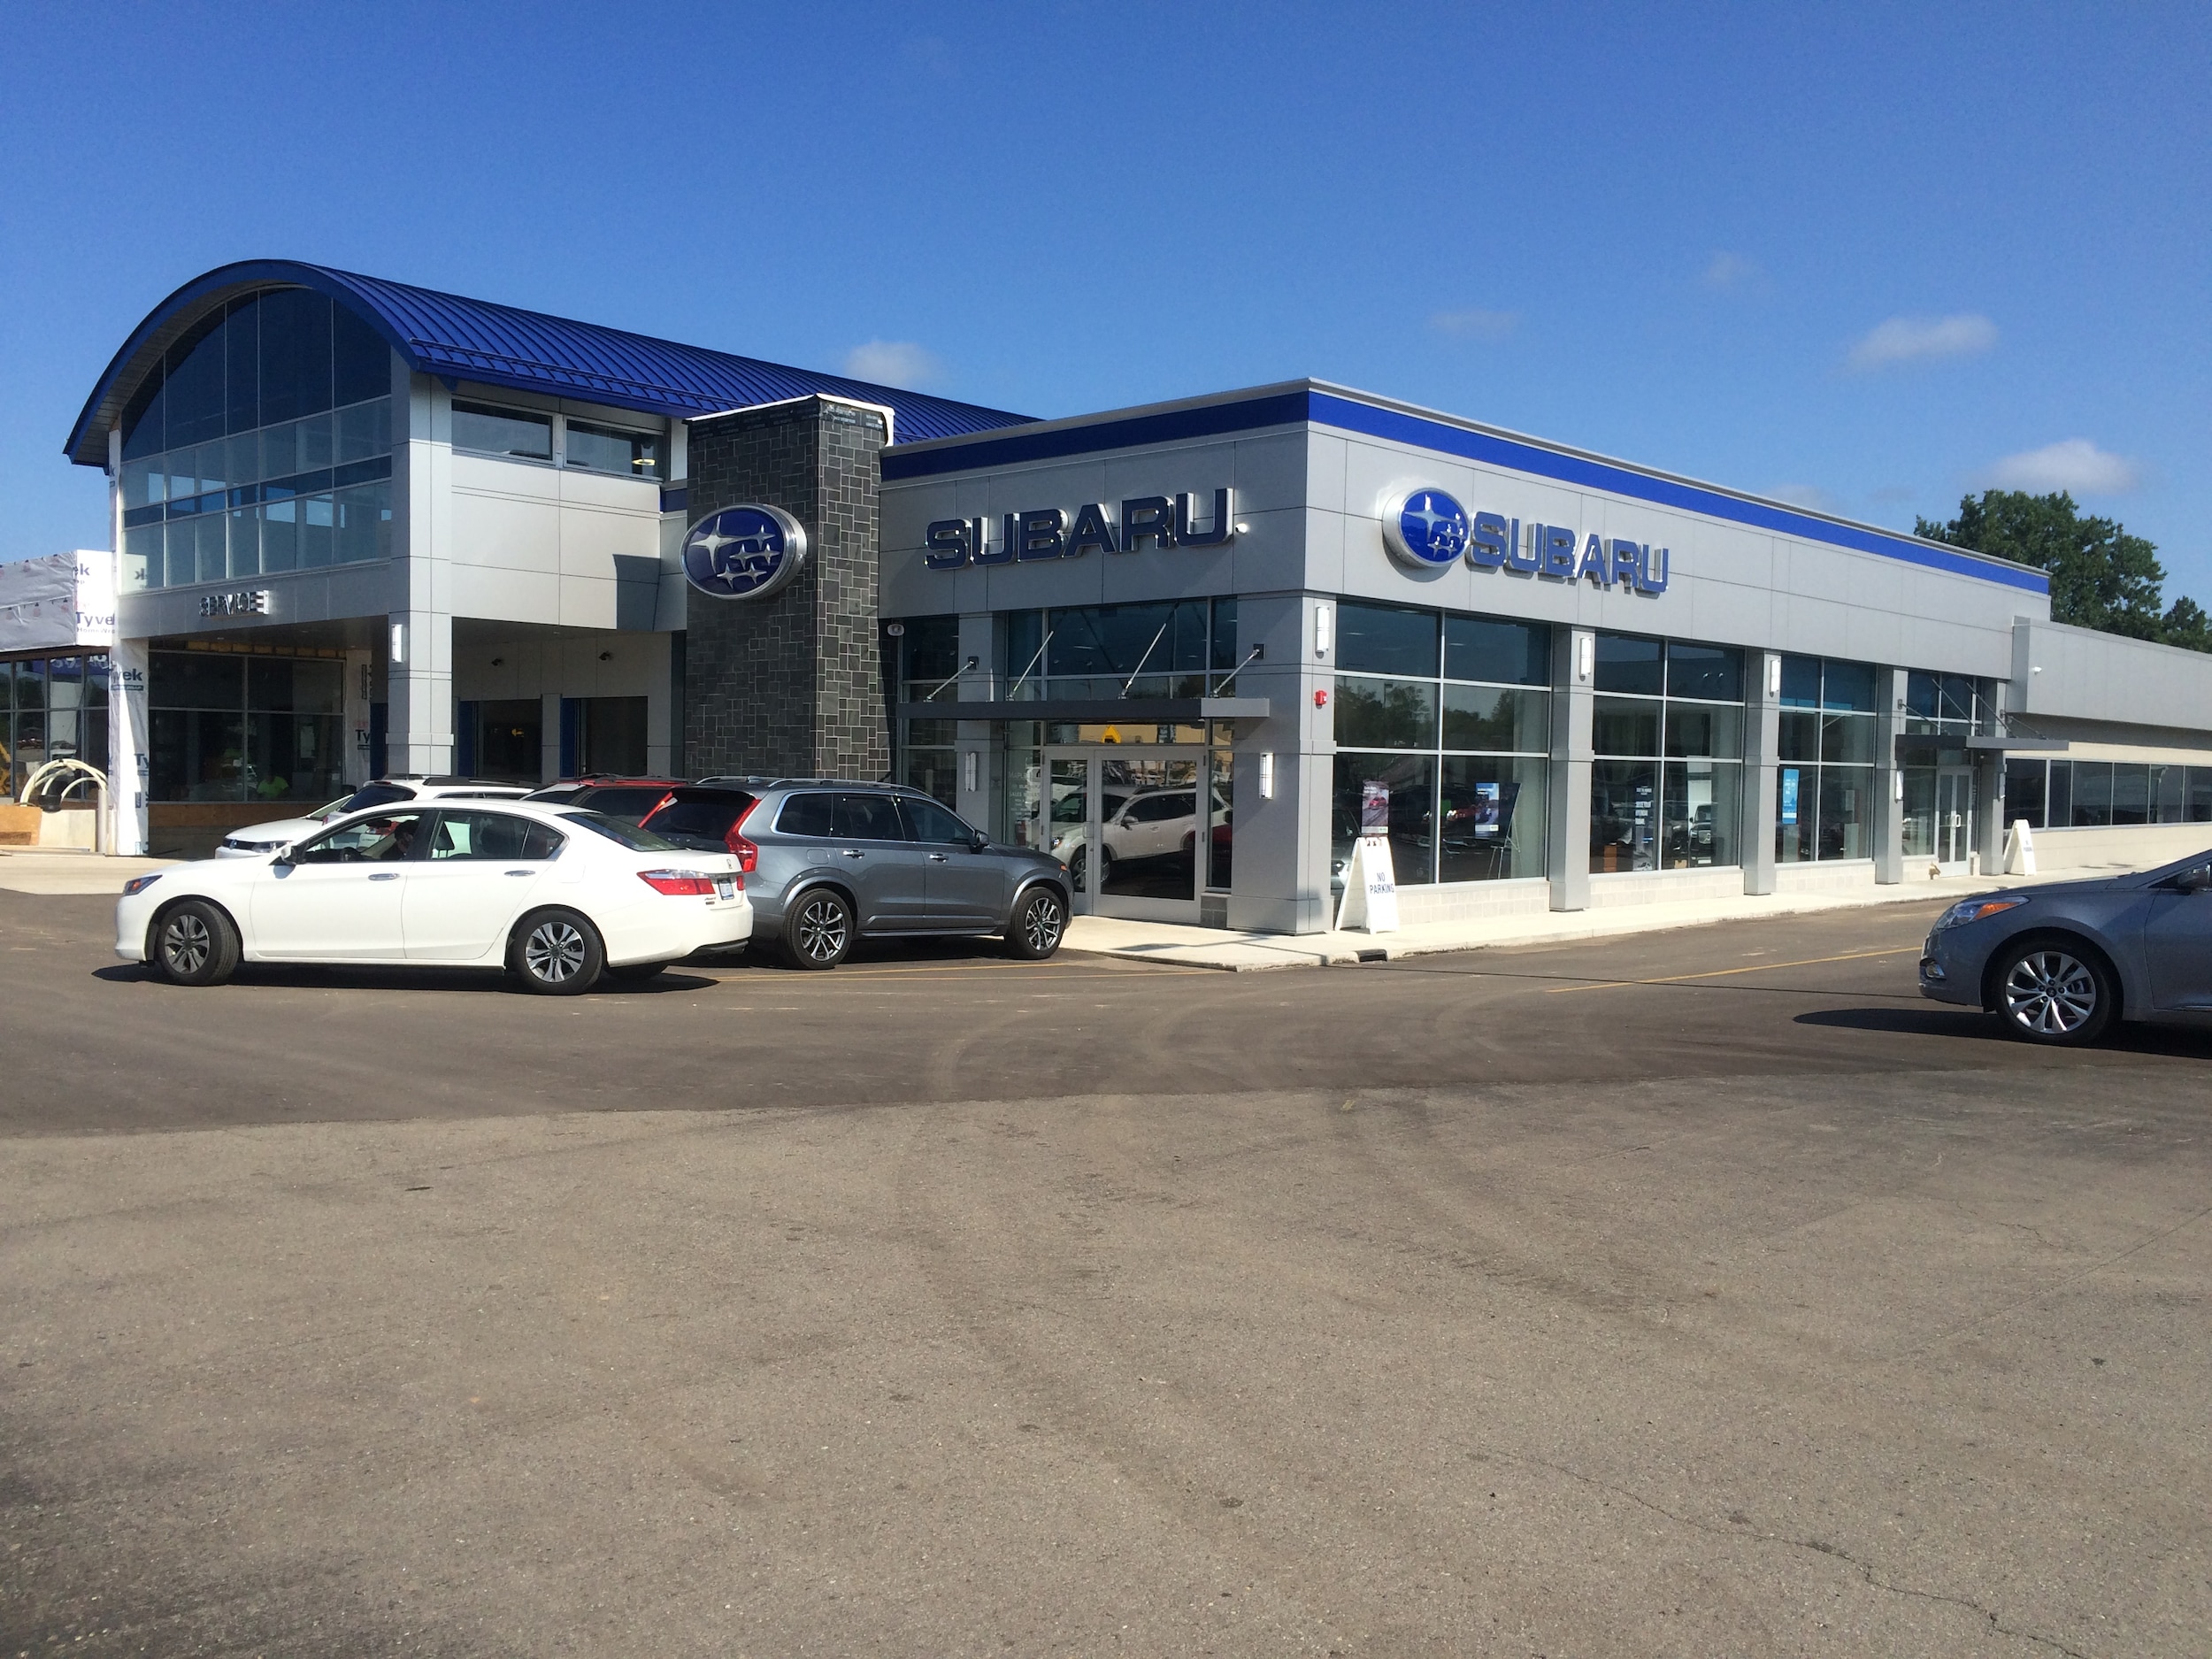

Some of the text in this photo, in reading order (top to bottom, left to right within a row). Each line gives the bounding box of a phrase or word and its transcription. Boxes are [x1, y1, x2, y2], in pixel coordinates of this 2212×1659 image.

[925, 488, 1233, 571] SUBARU
[1468, 511, 1670, 593] SUBARU
[199, 589, 270, 618] SERVICE
[1369, 883, 1395, 895] PARKING
[1376, 872, 1386, 882] NO
